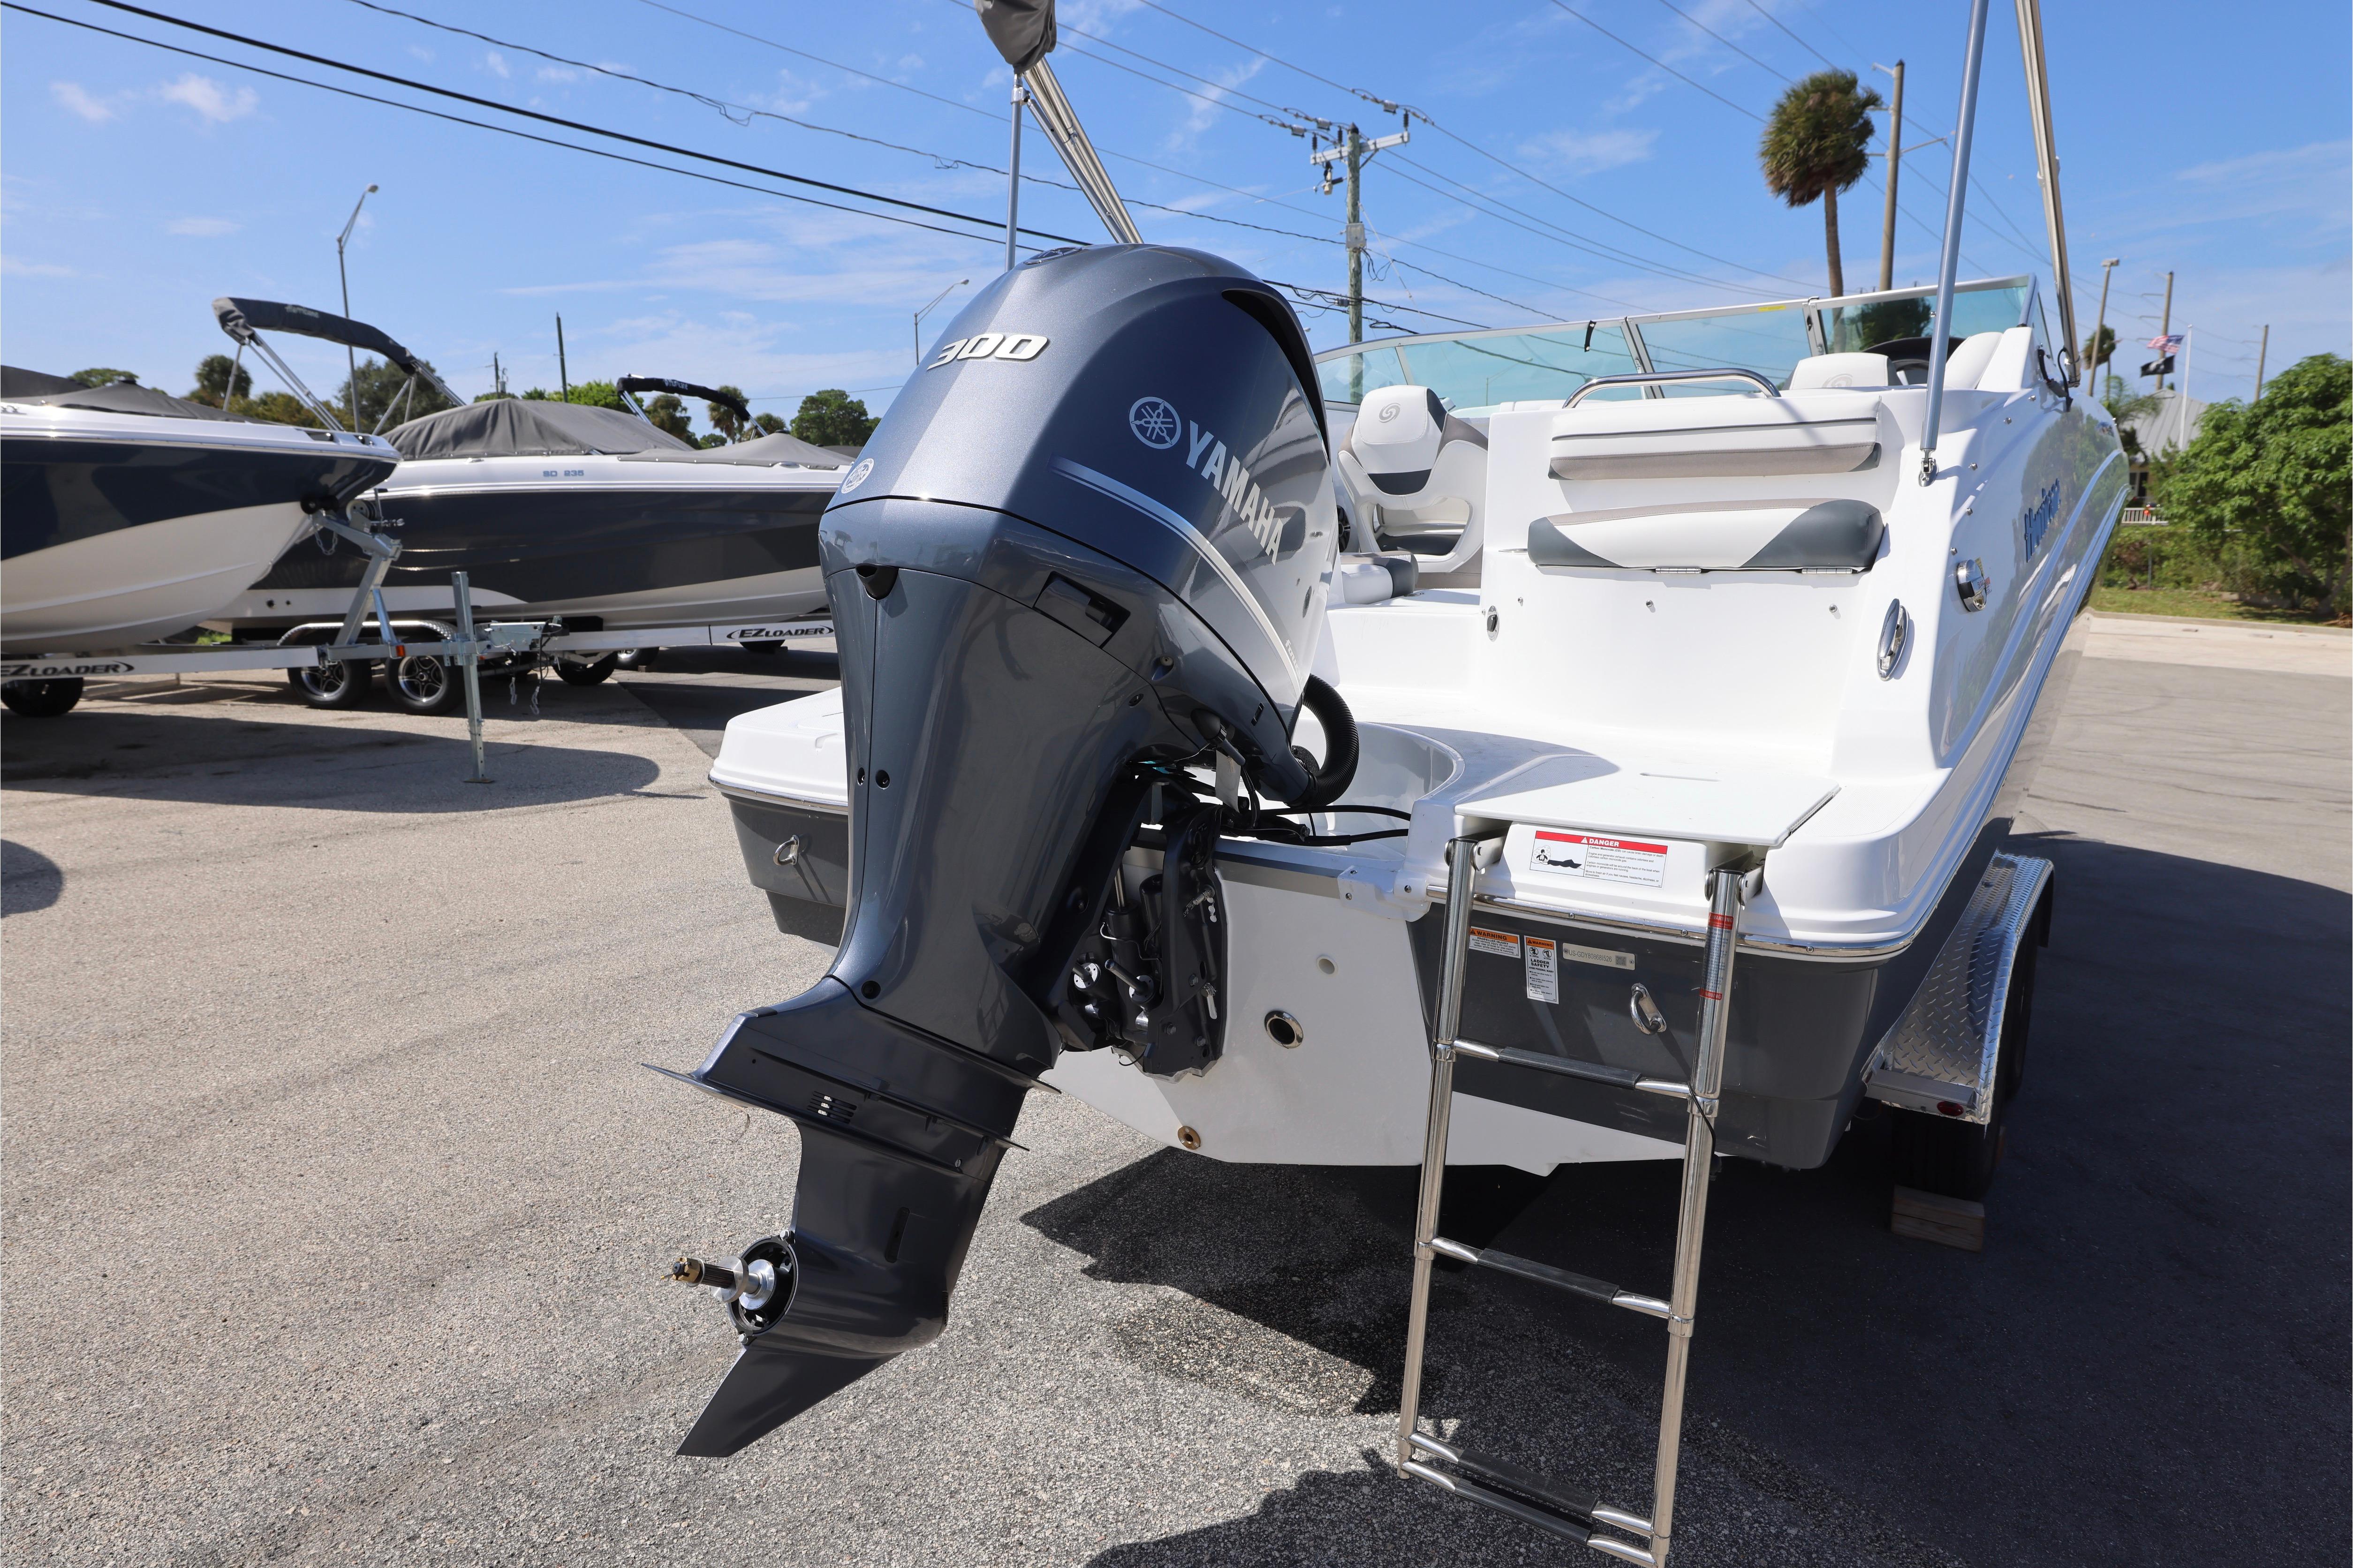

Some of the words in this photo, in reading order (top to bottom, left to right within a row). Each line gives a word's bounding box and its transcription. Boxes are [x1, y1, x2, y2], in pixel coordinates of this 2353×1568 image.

[927, 333, 1048, 370] 300
[1186, 420, 1284, 566] YAMAHA
[1589, 838, 1619, 847] DANGER
[1477, 930, 1507, 941] WARNING
